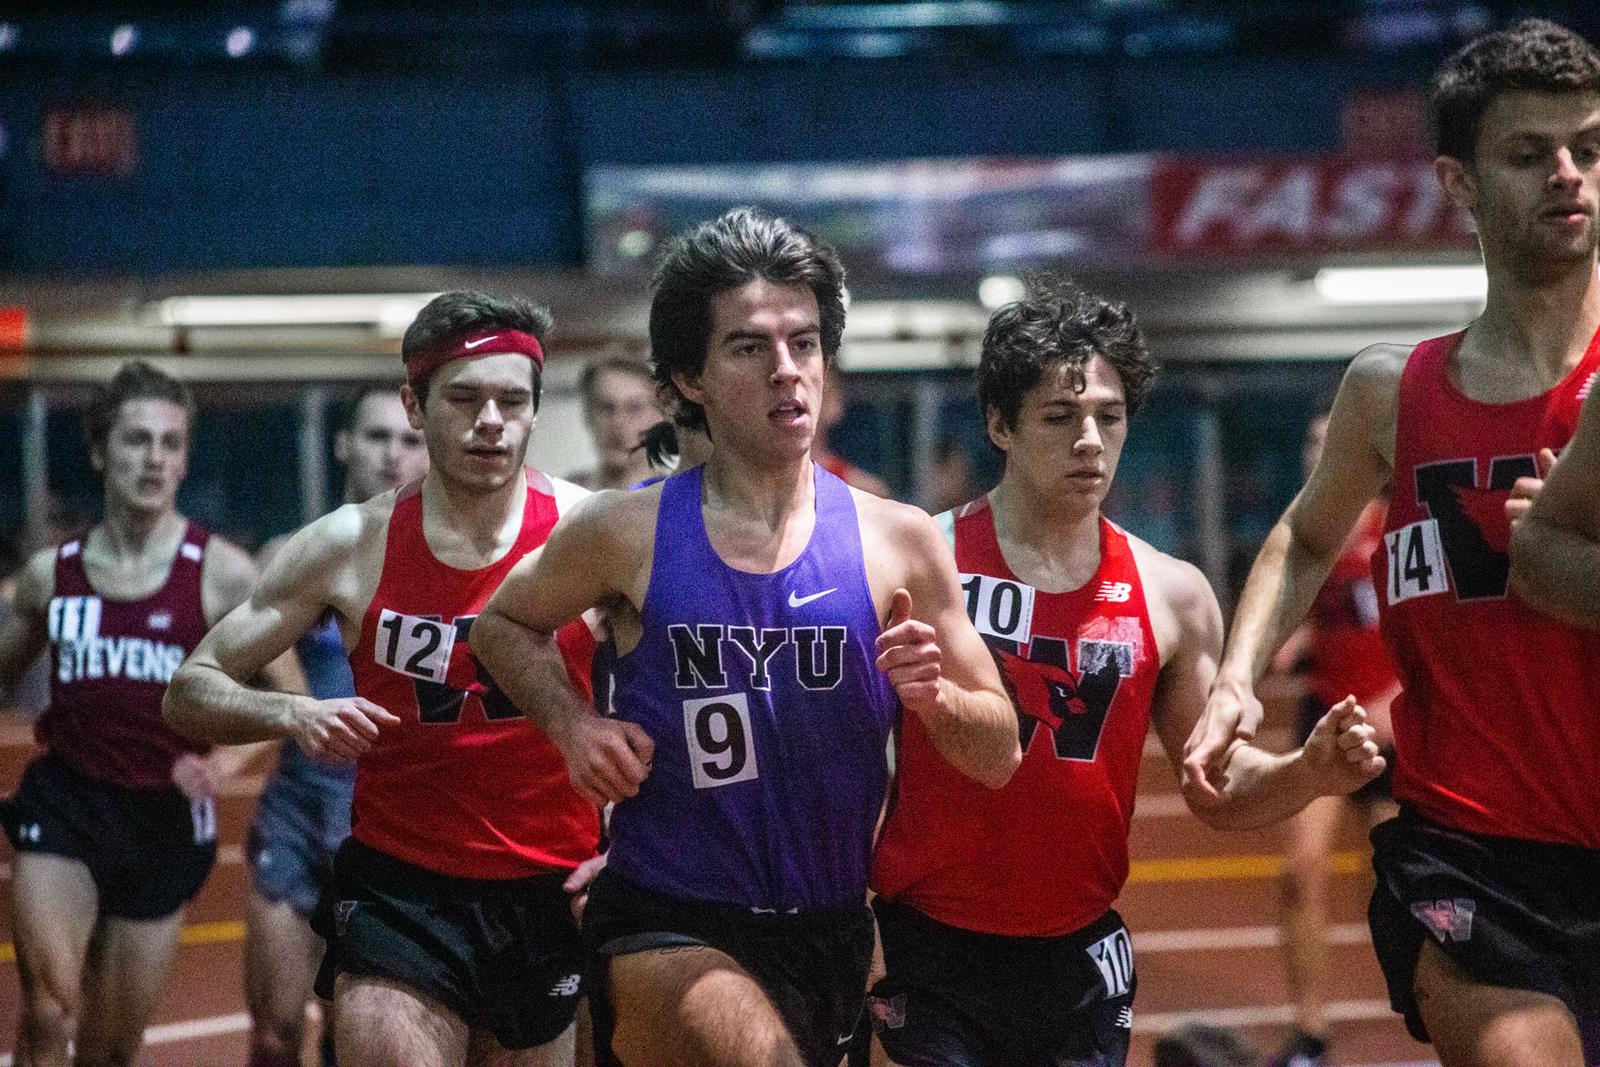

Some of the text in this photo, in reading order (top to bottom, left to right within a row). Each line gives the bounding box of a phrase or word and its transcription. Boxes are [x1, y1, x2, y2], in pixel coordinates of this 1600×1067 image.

[1173, 164, 1479, 243] FAST
[1391, 524, 1432, 598] 14
[962, 575, 1022, 636] 10
[58, 636, 185, 682] STEVENS
[382, 615, 442, 678] 12
[668, 624, 847, 691] NYU
[695, 702, 747, 780] 9
[1097, 932, 1131, 994] 10
